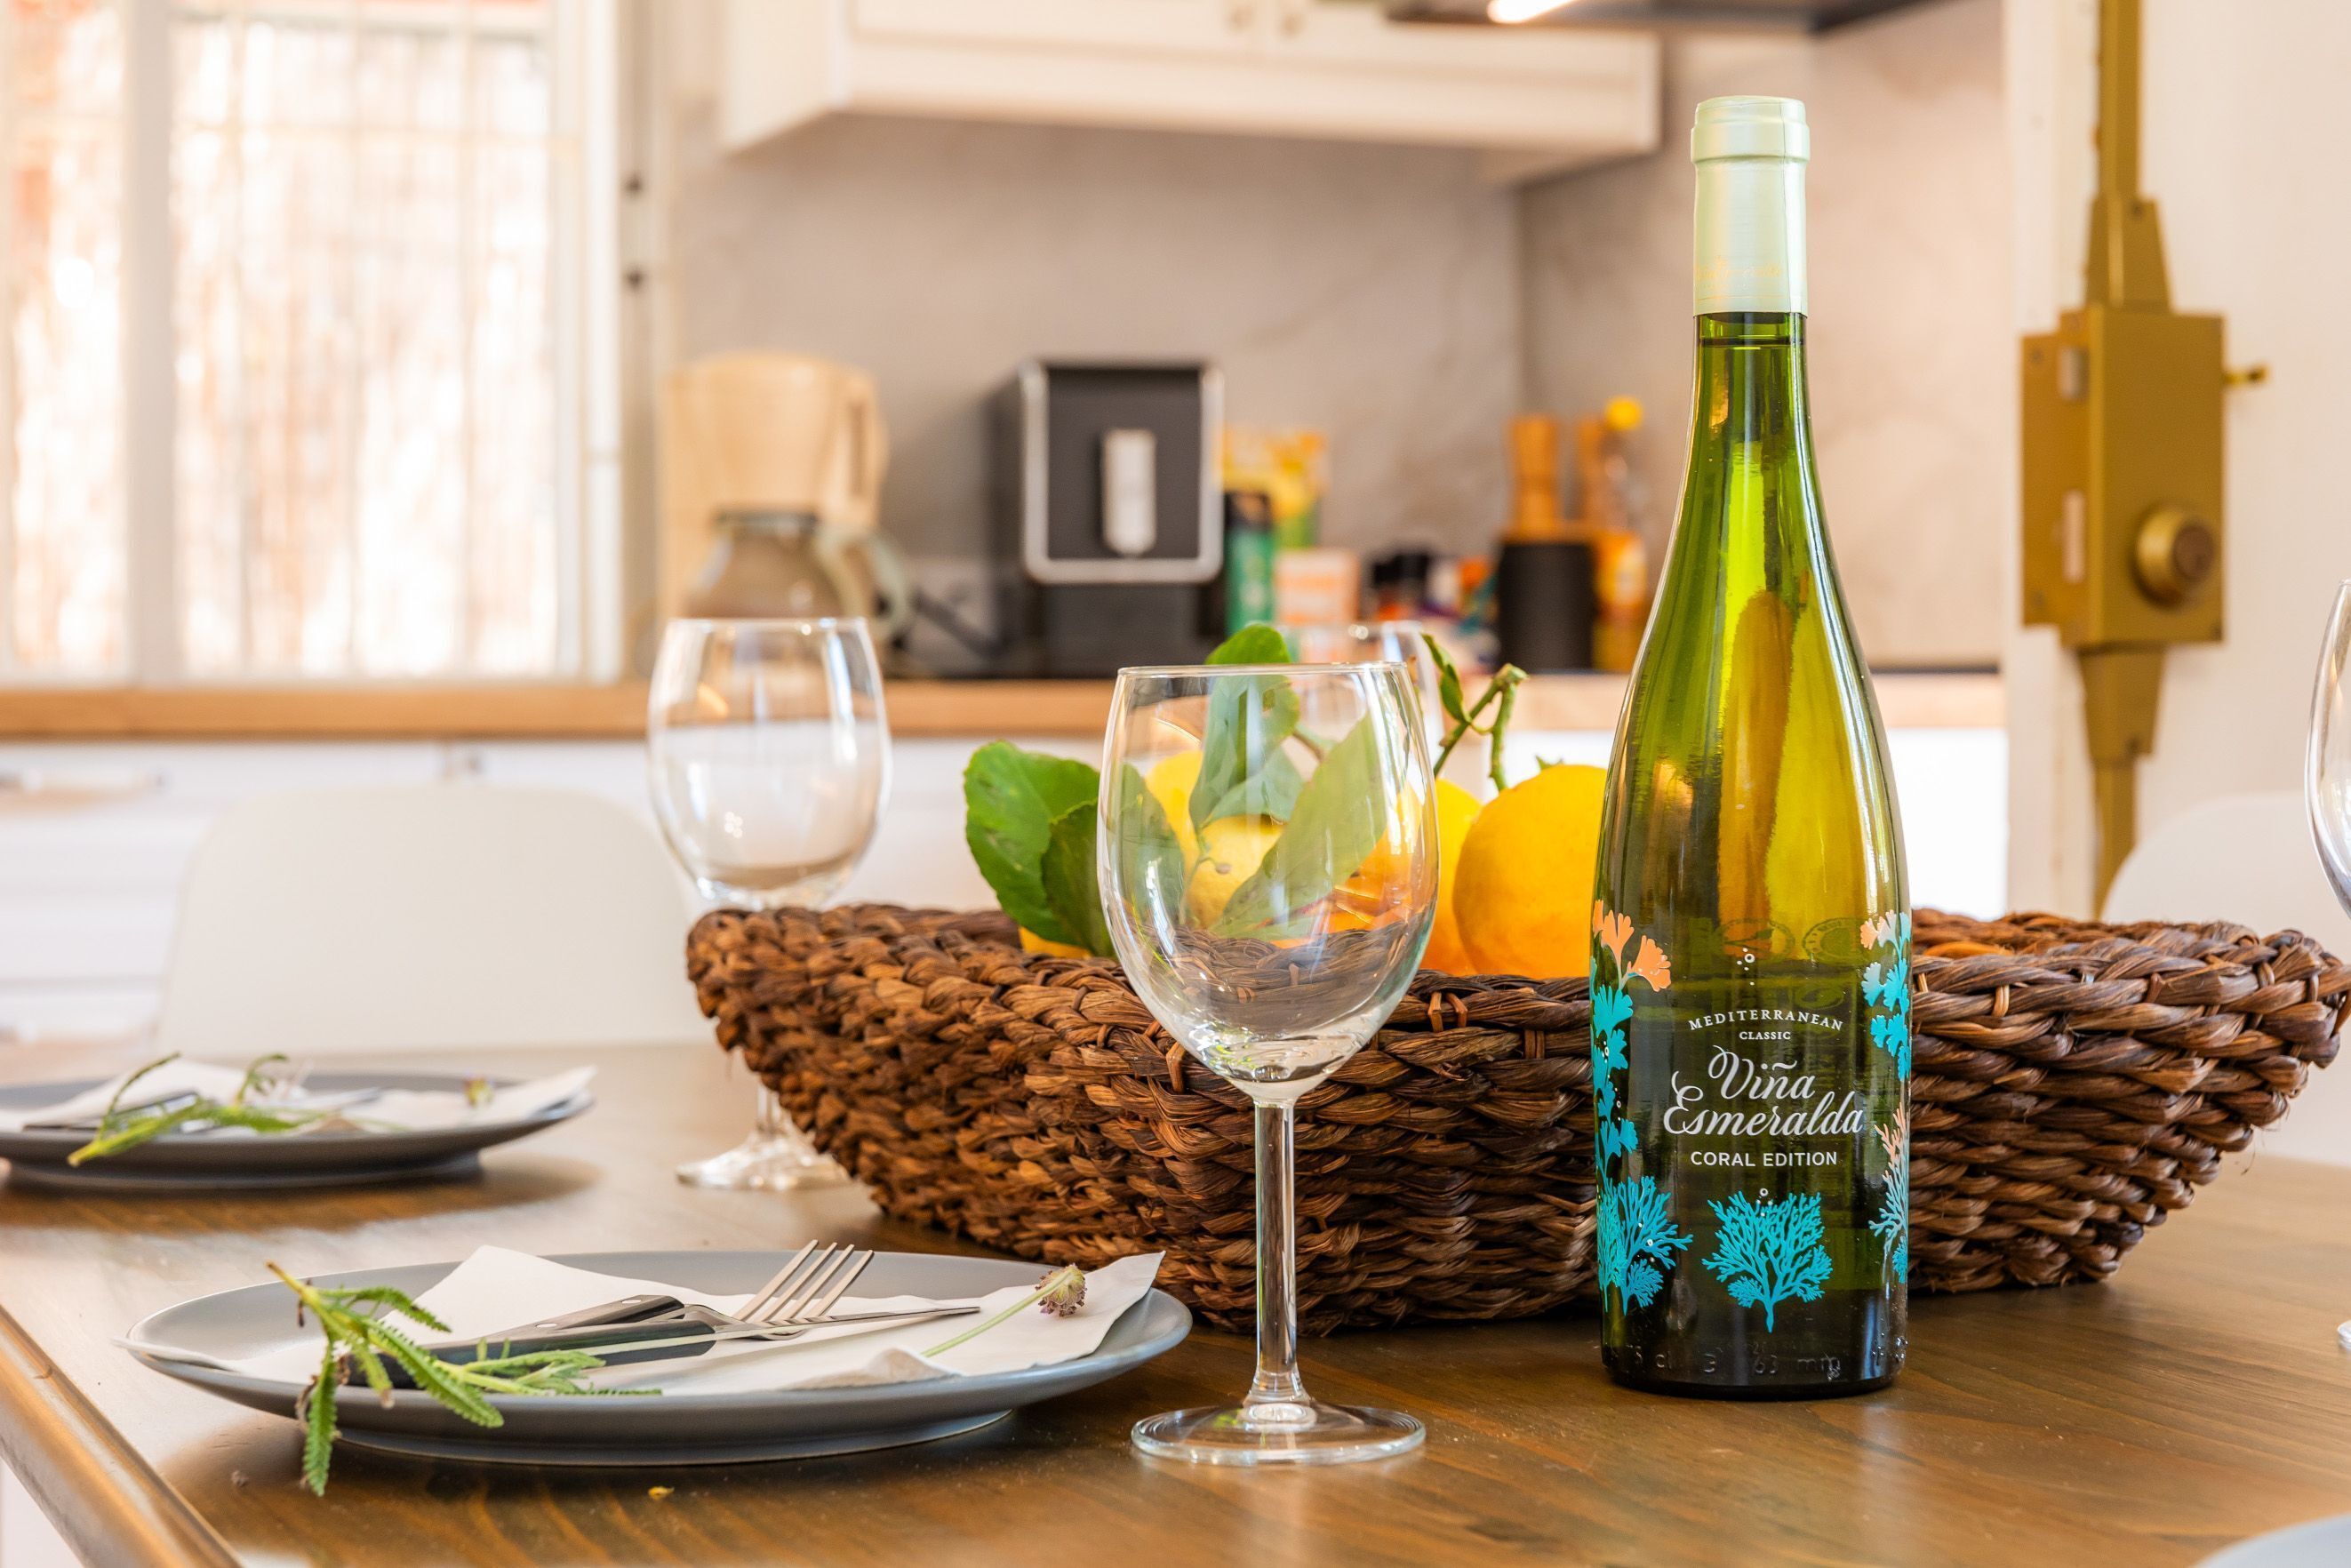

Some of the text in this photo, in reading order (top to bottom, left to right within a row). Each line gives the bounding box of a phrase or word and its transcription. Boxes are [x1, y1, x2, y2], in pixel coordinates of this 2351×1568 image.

[1689, 1009, 1843, 1031] MEDITERRANEAN
[1739, 1031, 1791, 1040] CLASSIC
[1707, 1044, 1816, 1100] Viña
[1663, 1070, 1864, 1136] Esmeralda
[1691, 1151, 1837, 1167] CORAL EDITION
